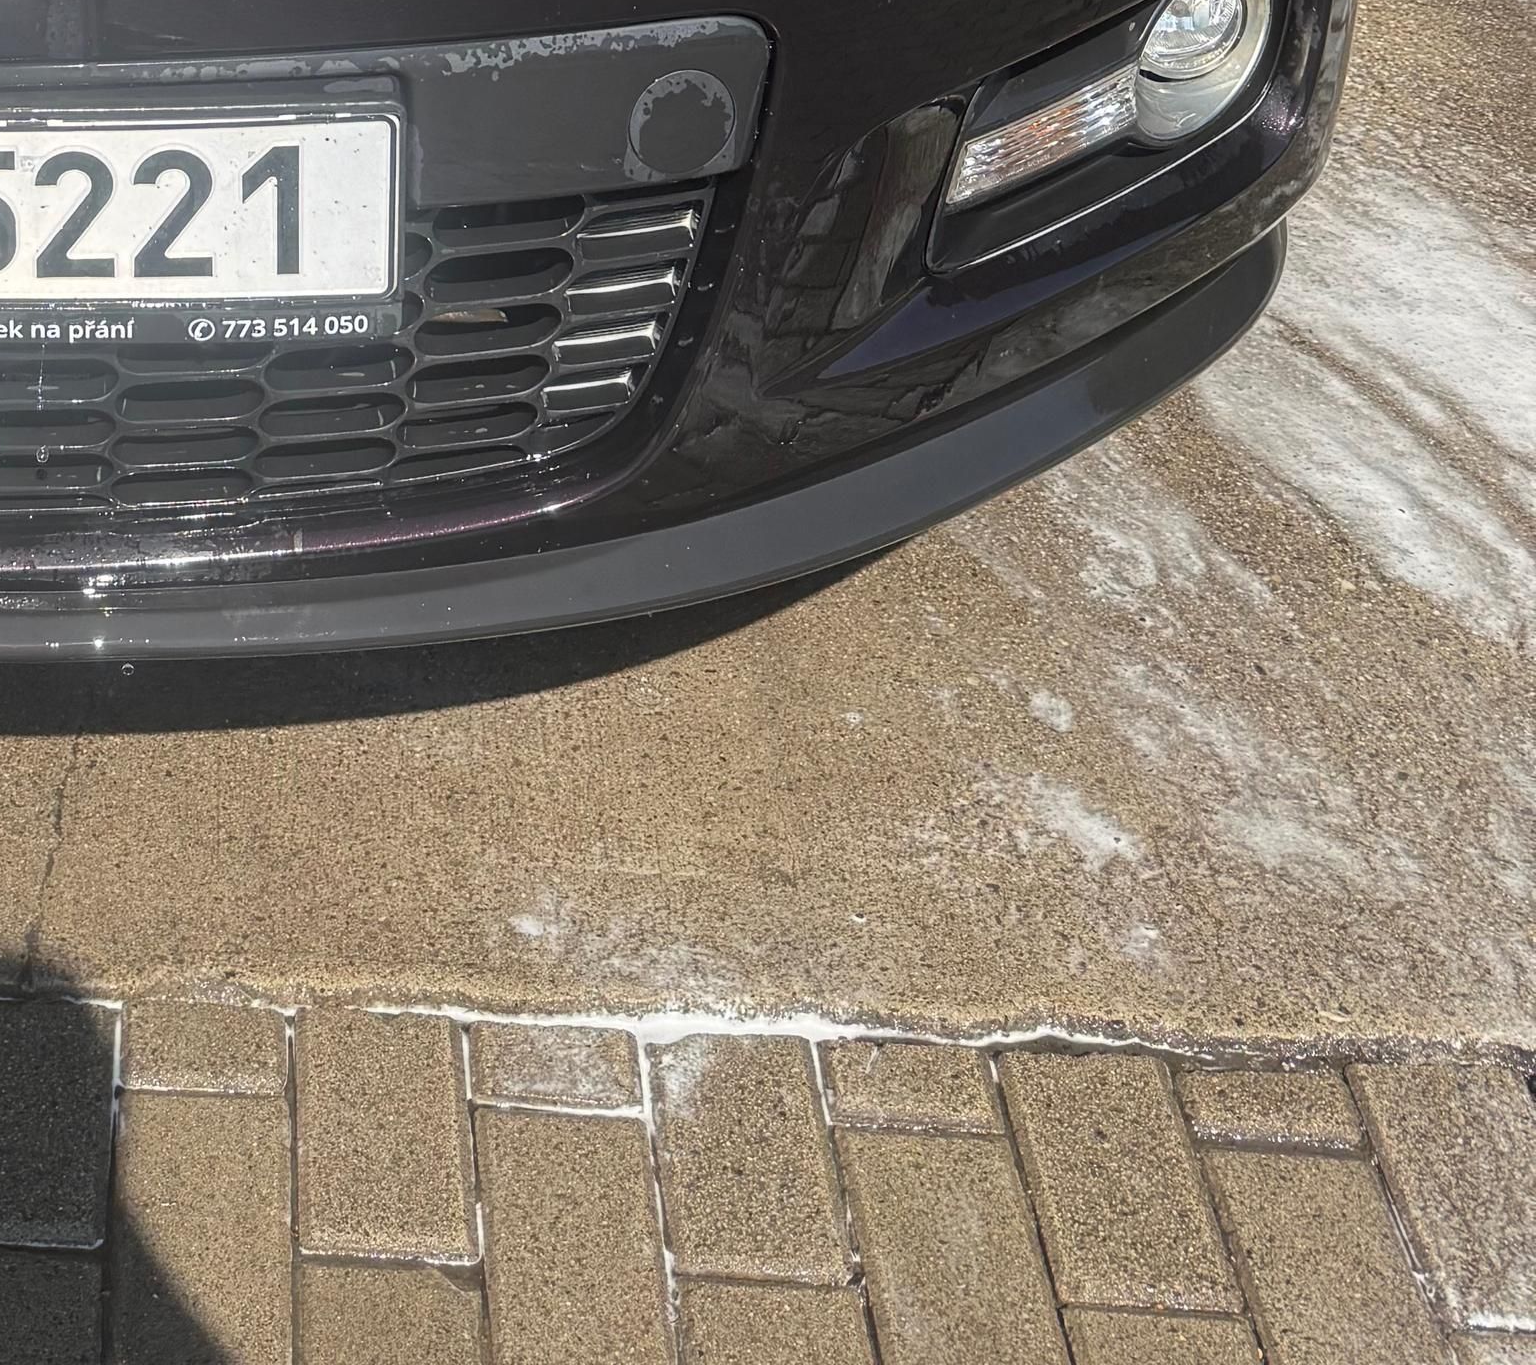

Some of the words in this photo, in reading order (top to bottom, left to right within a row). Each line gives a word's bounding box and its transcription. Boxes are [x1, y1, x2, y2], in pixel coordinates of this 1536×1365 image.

[32, 323, 61, 339] na
[68, 317, 134, 345] přání
[221, 319, 267, 339] 773
[273, 317, 319, 337] 514
[323, 314, 369, 335] 050
